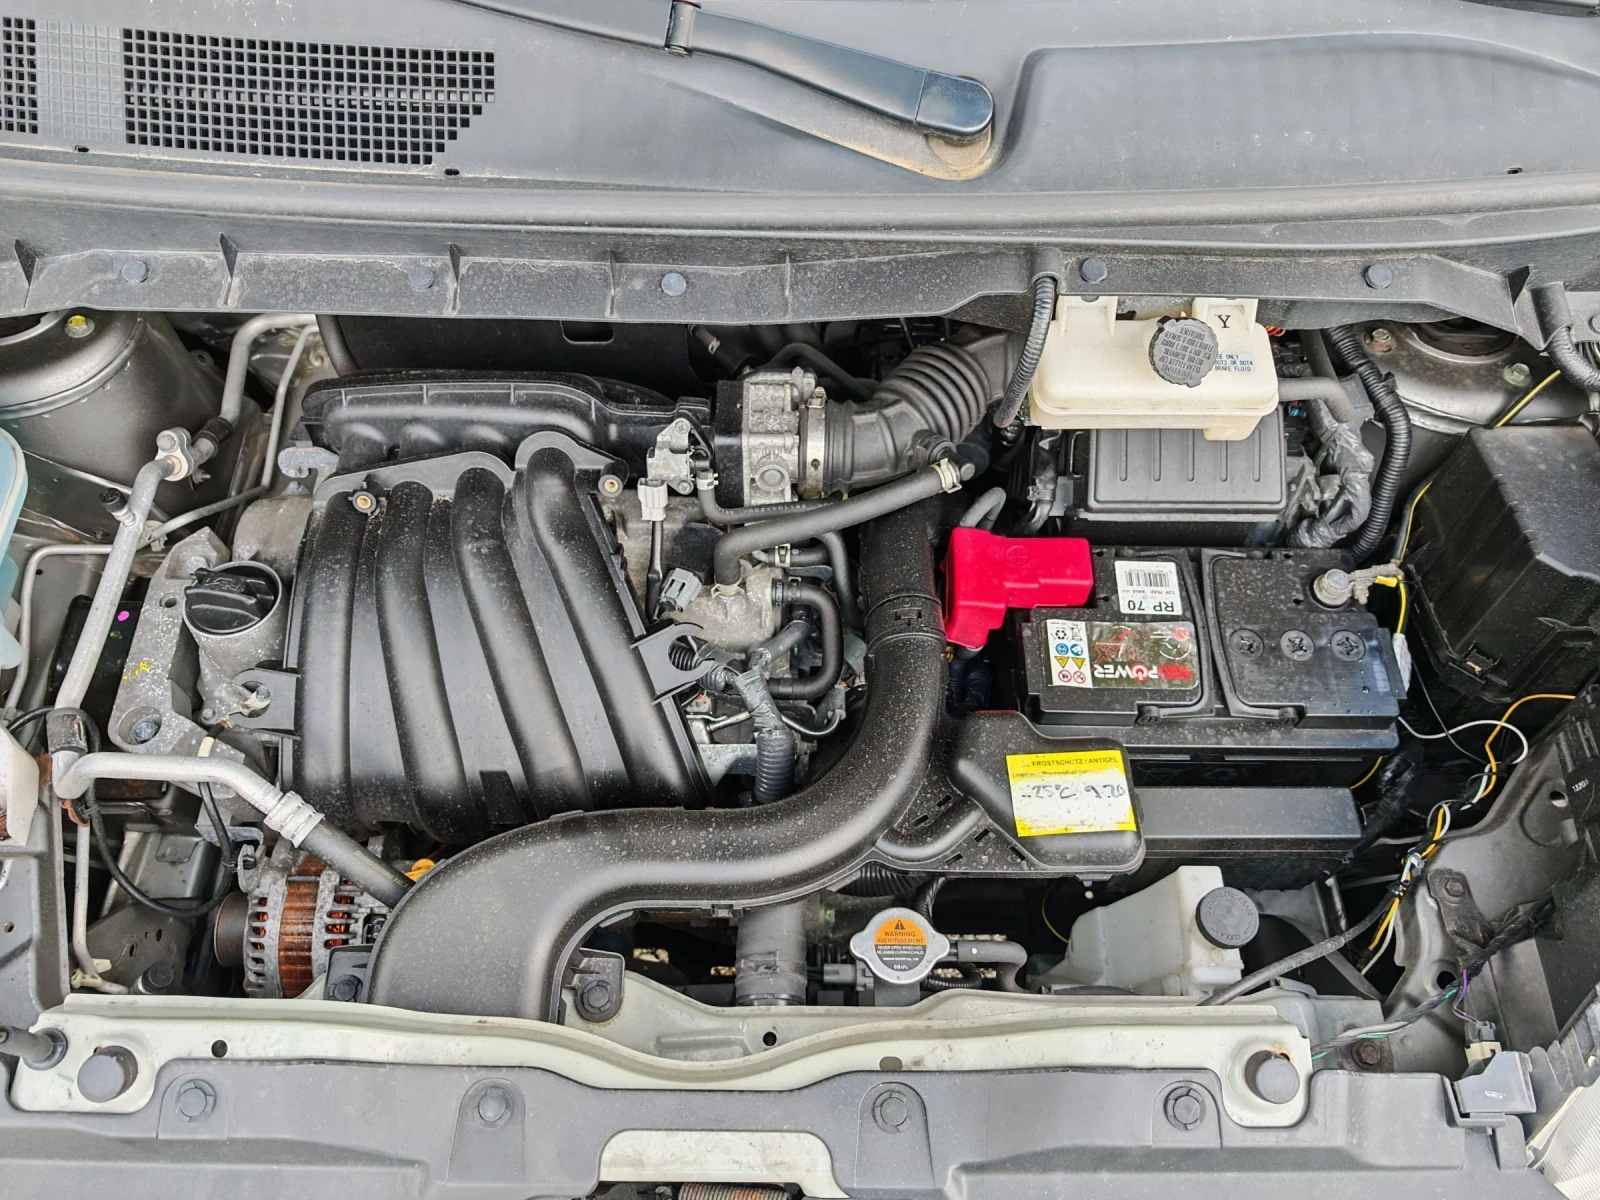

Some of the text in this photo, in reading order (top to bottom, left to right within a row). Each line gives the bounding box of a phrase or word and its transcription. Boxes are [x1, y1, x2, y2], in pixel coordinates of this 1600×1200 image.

[1217, 314, 1231, 328] Y
[1127, 599, 1175, 612] RP 70
[1088, 756, 1118, 764] ANTIGEL
